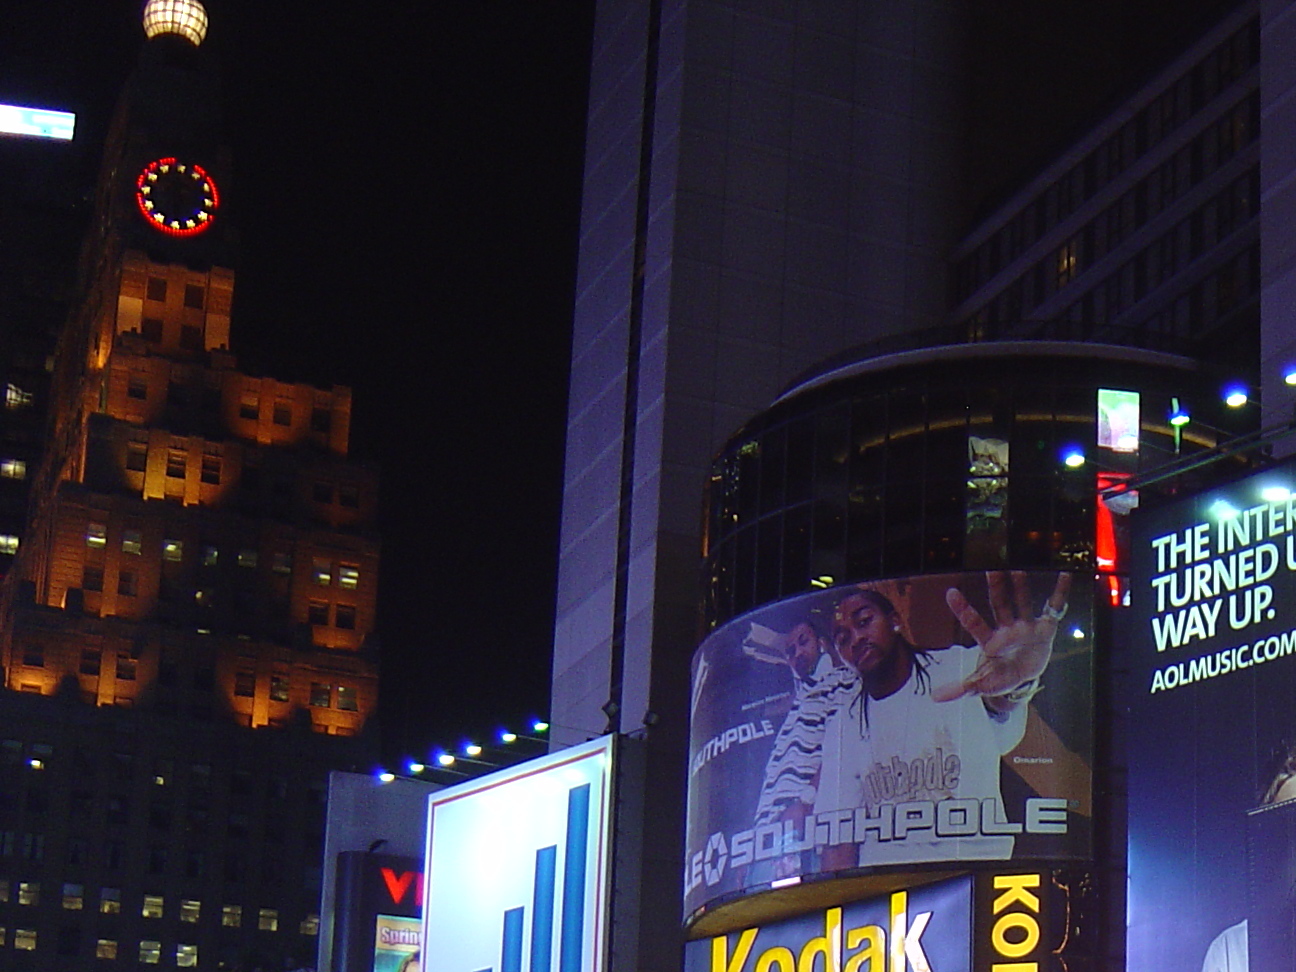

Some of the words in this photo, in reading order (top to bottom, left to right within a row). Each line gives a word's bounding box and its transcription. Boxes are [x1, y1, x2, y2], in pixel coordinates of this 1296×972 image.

[1151, 520, 1211, 573] THE
[1151, 545, 1279, 613] TURNED
[1151, 598, 1223, 653] WAY
[1229, 584, 1276, 631] UP.
[730, 797, 1069, 869] SOUTHPOLE
